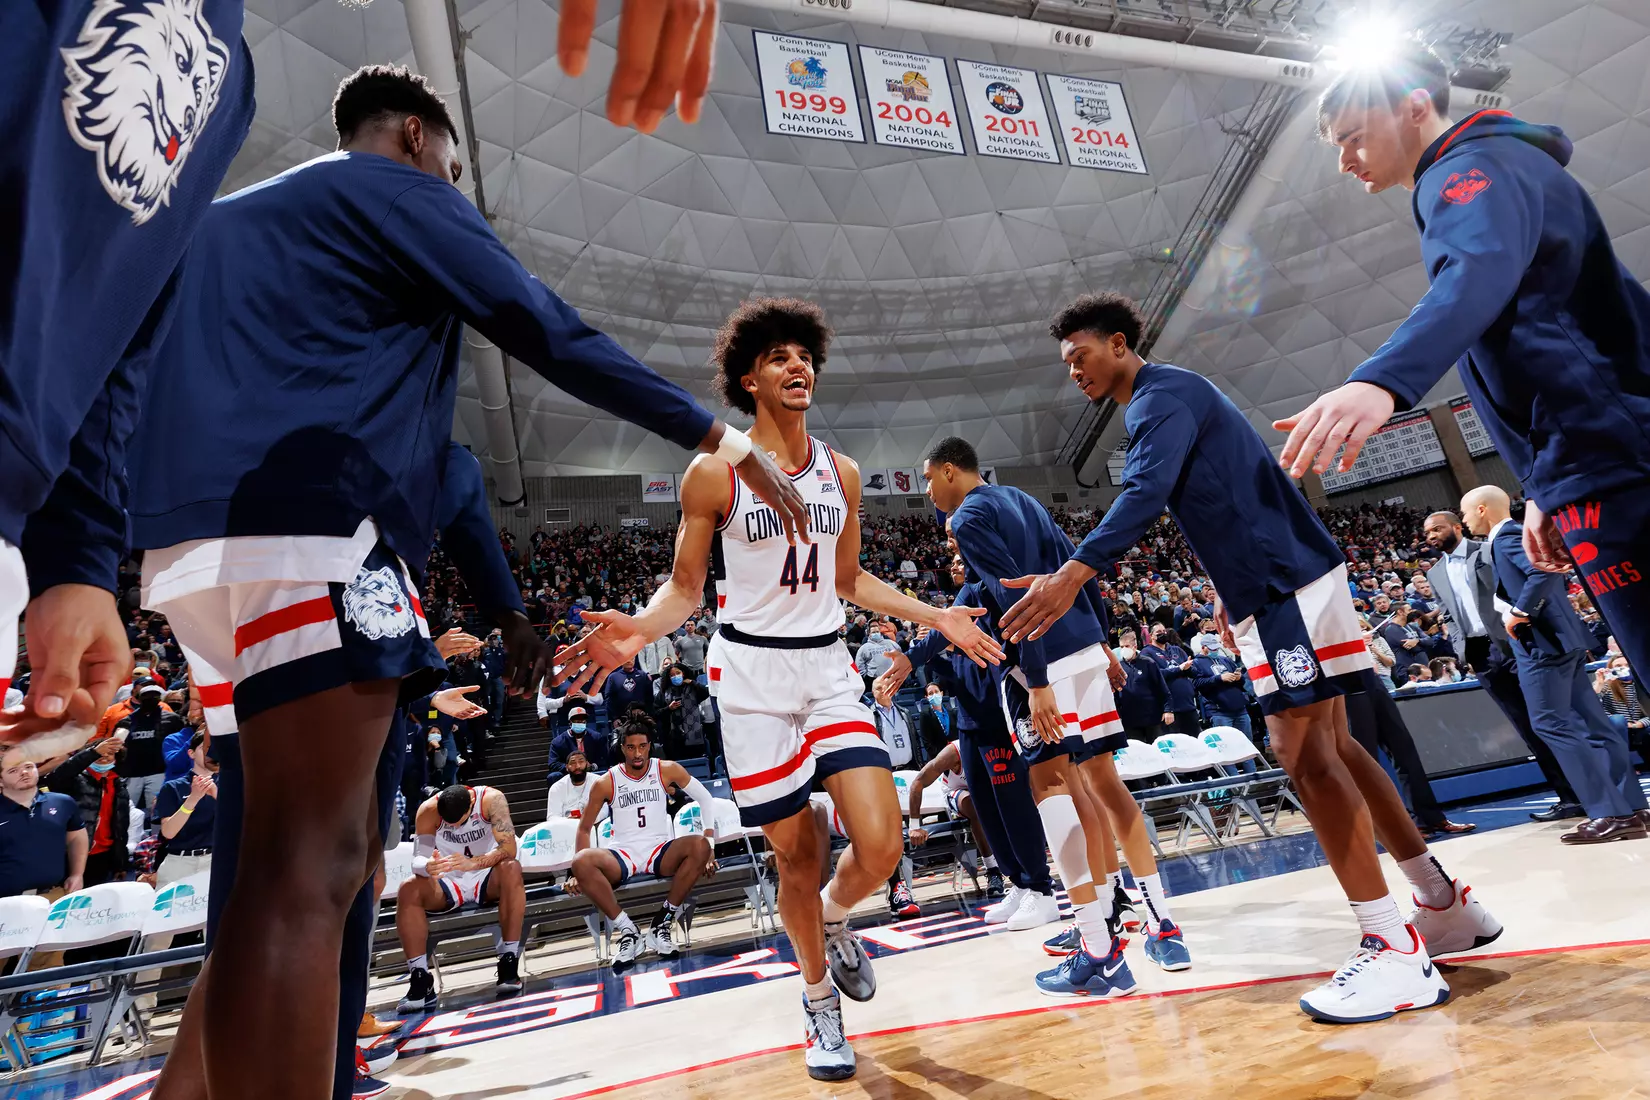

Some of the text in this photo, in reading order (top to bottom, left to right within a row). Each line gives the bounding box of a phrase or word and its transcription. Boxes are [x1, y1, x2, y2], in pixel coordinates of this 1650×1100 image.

[772, 36, 831, 50] UConn Men's
[779, 45, 828, 57] Basketball
[875, 50, 930, 63] UConn Men's
[882, 59, 927, 71] Basketball
[971, 63, 1023, 77] UConn Men's
[979, 72, 1021, 83] Basketball
[1060, 77, 1109, 90] UConn Men's
[1067, 86, 1106, 96] Basketball
[775, 90, 847, 115] 1999
[782, 112, 847, 127] NATIONAL
[876, 102, 952, 128] 2004
[778, 123, 854, 139] CHAMPIONS
[888, 123, 948, 139] NATIONAL
[984, 114, 1040, 137] 2011
[885, 134, 955, 150] CHAMPIONS
[988, 134, 1044, 149] NATIONAL
[1071, 126, 1129, 149] 2014
[986, 144, 1051, 160] CHAMPIONS
[1078, 146, 1132, 160] NATIONAL
[1077, 156, 1138, 170] CHAMPIONS
[1381, 432, 1396, 441] 1995
[1399, 426, 1414, 436] 1996
[1417, 422, 1431, 431] 1997
[1368, 446, 1382, 456] 2001
[1385, 441, 1399, 451] 2002
[1402, 436, 1417, 446] 2003
[1420, 432, 1436, 442] 2004
[1389, 451, 1403, 461] 2011
[1406, 447, 1421, 456] 2014
[1424, 442, 1439, 452] 2015
[1470, 440, 1484, 450] 2017
[1325, 461, 1448, 495] CONNECTICUT WOMEN'S BASKETBALL
[1341, 475, 1354, 484] 2017
[1411, 456, 1425, 466] 2021
[780, 543, 819, 595] 44
[985, 748, 1014, 763] UCONN
[618, 788, 660, 809] CONNECTICUT
[637, 806, 647, 828] 5
[69, 907, 112, 921] Select
